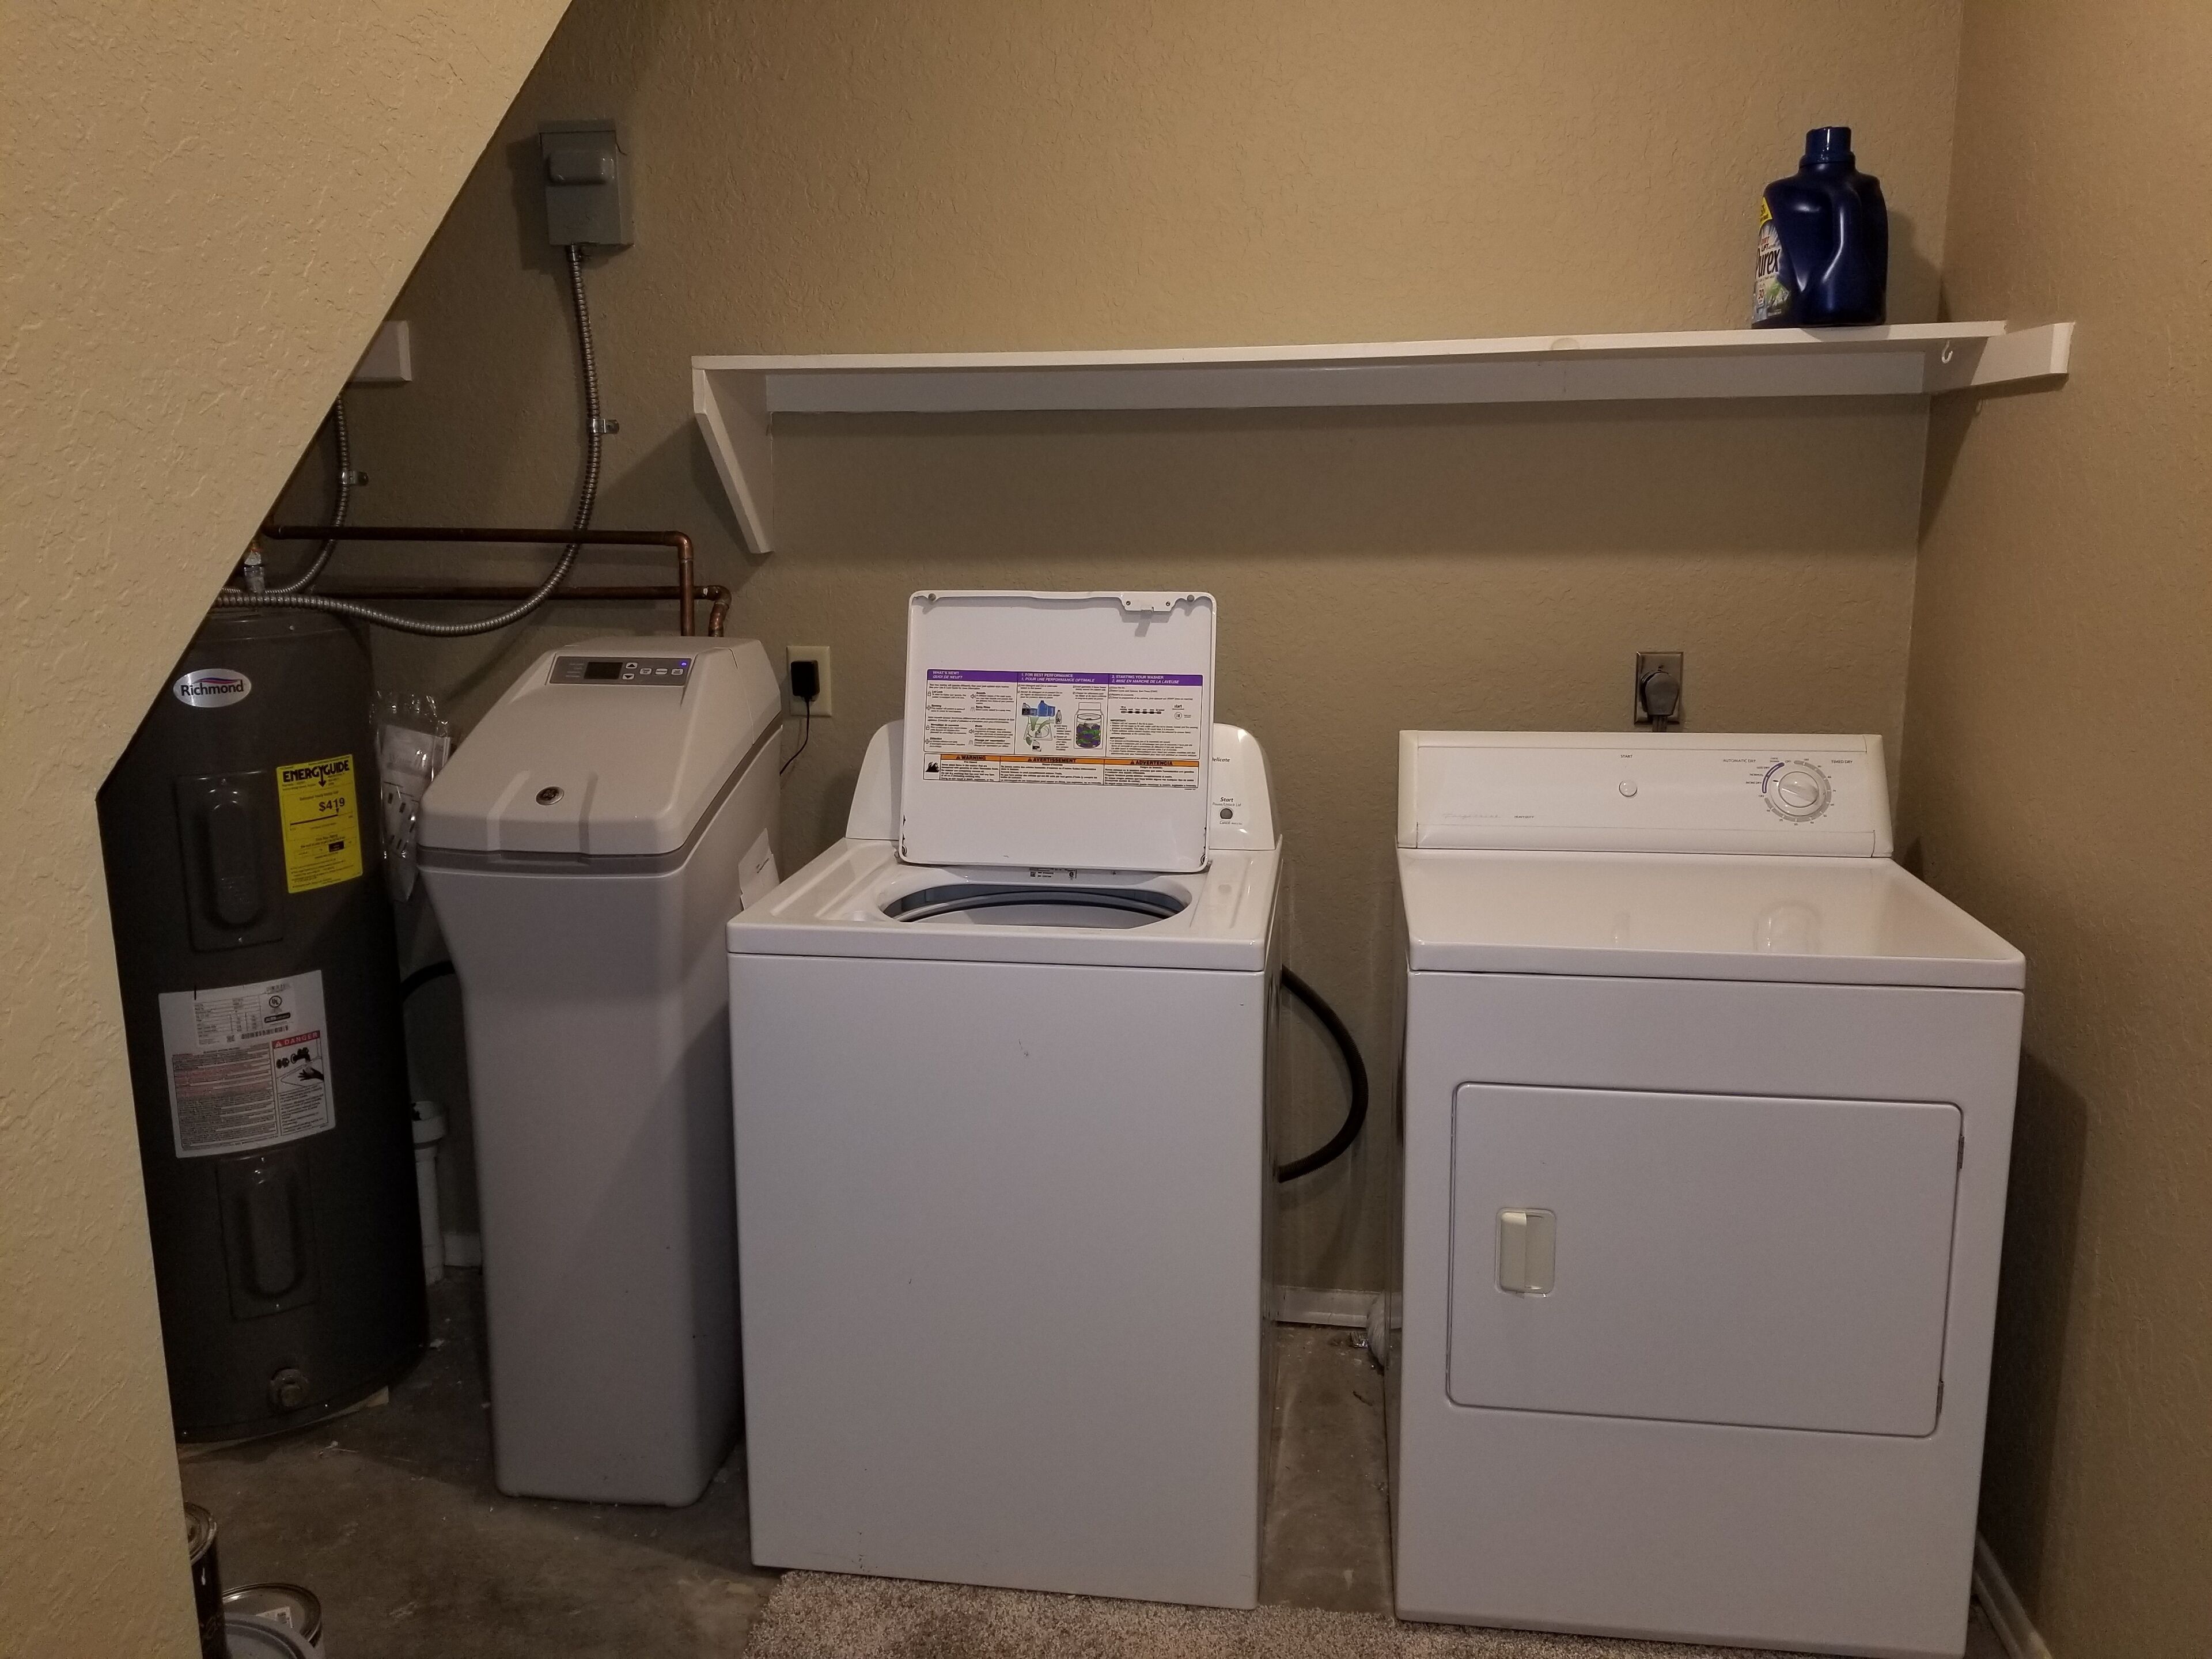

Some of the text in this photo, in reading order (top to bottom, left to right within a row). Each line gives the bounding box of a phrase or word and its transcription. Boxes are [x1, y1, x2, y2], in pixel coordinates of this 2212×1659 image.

[180, 679, 244, 696] Richmond
[282, 760, 350, 783] ENERGYGUIDE
[319, 798, 346, 812] $419
[284, 1031, 319, 1045] DANGER
